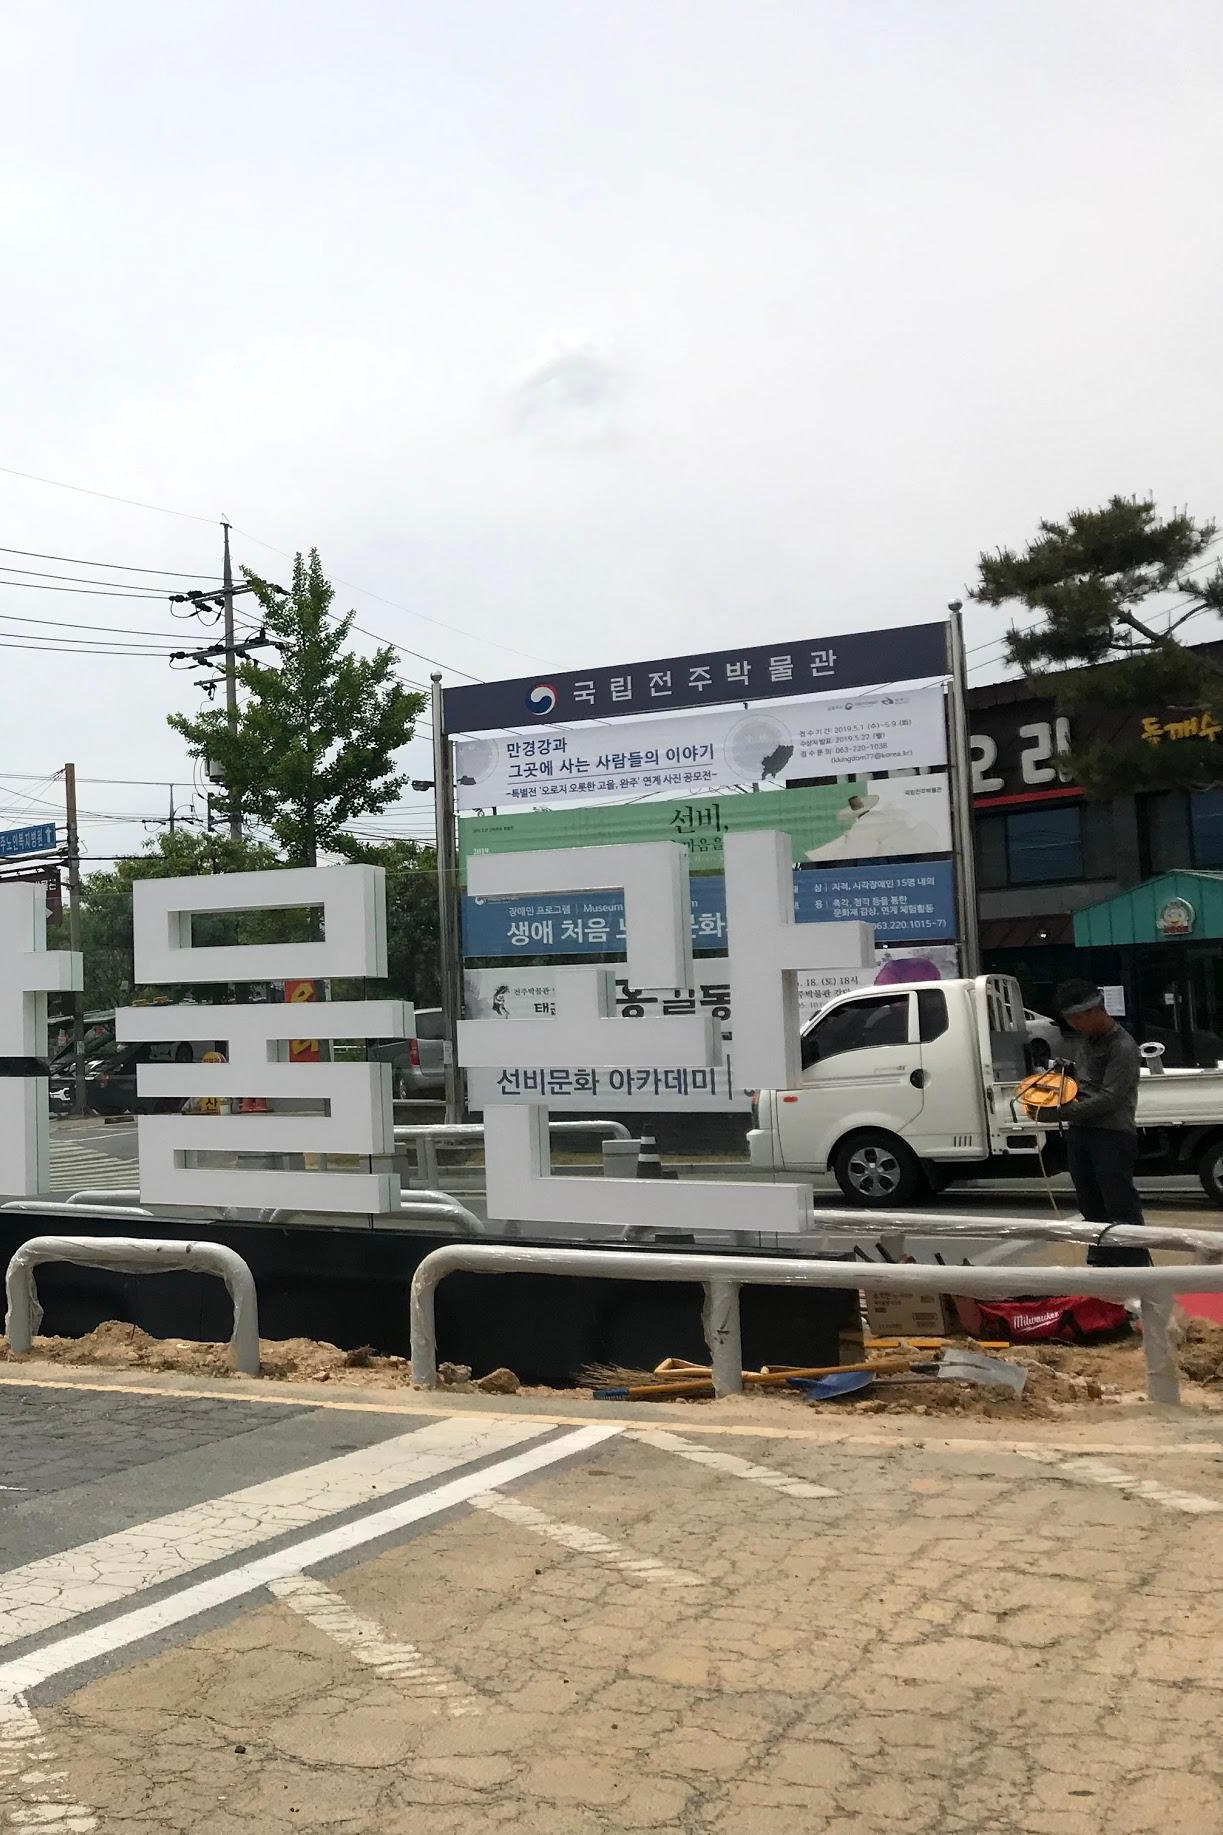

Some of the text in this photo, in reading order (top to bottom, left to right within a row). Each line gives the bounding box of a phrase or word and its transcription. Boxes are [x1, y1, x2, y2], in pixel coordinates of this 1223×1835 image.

[573, 649, 837, 705] 국립전주박물관
[506, 737, 568, 758] 만경강과
[508, 743, 715, 779] 그곳에 사는 사람들의 이야기
[642, 774, 662, 787] 연계
[663, 773, 682, 785] 사진
[508, 903, 624, 917] 장애인 프로그램 Museum
[506, 918, 554, 946] 생애
[561, 916, 610, 944] 처음
[496, 1066, 716, 1096] 선비문화 아카데미
[1013, 1310, 1061, 1330] Milwaukee
